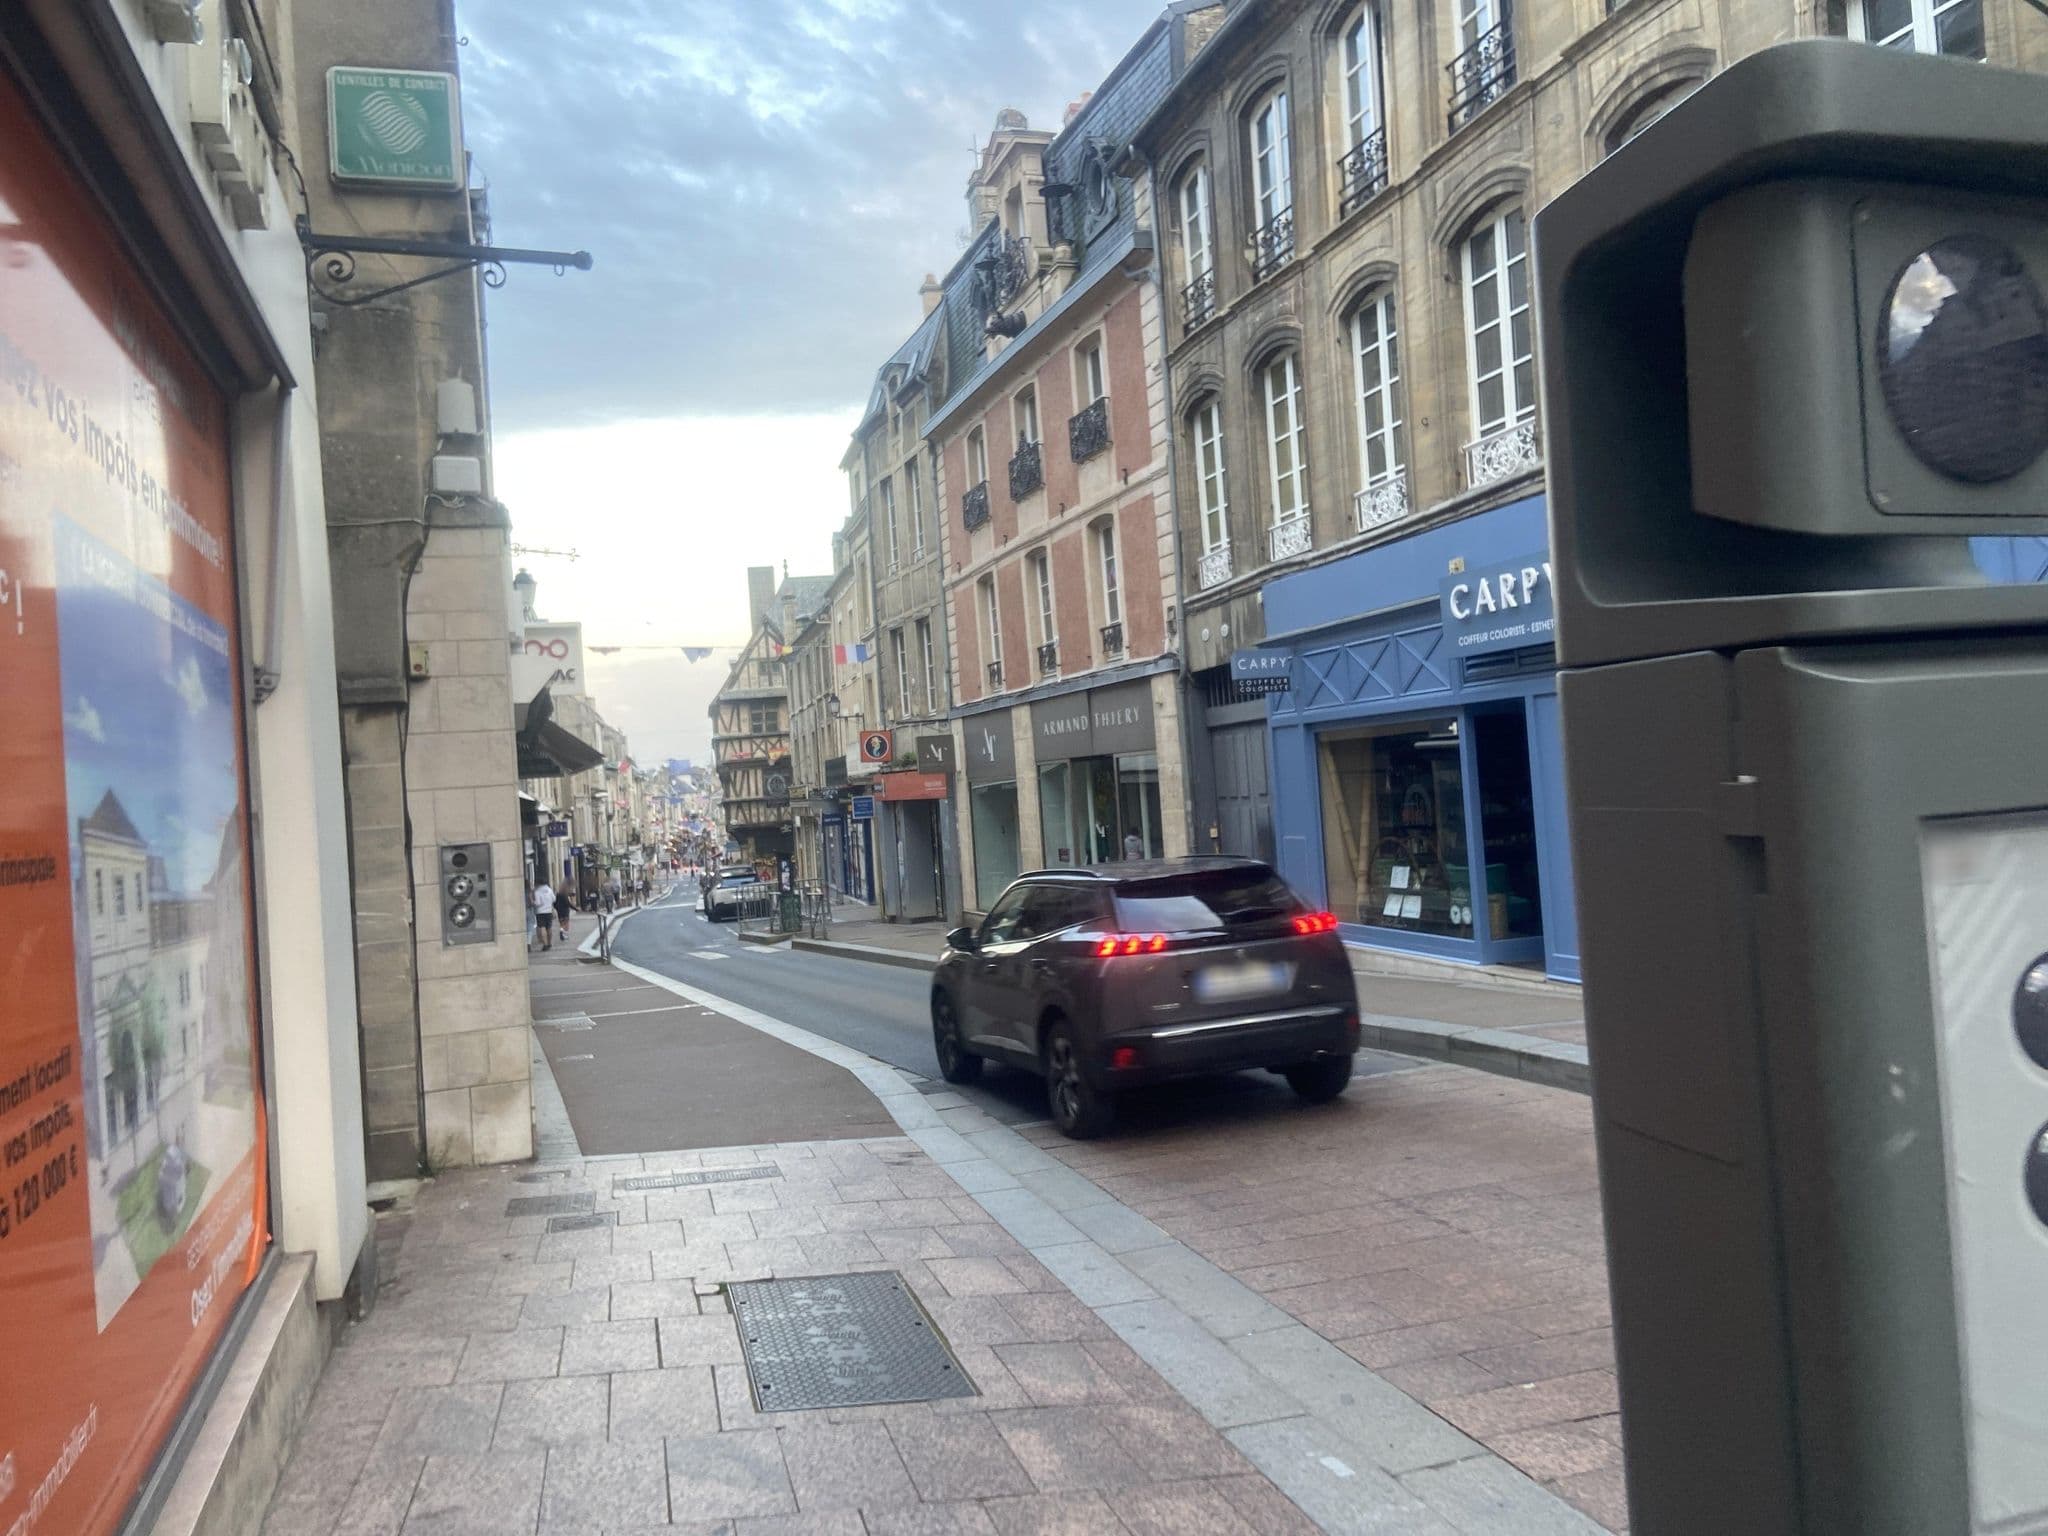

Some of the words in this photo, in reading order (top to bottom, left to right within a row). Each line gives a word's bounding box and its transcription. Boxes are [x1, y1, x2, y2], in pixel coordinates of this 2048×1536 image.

[81, 396, 138, 495] impôts
[1458, 633, 1488, 647] COIFFEUR
[1489, 624, 1525, 641] COLORISTE
[1531, 619, 1554, 633] ESTHET
[1237, 656, 1287, 670] CARPY
[1239, 678, 1288, 687] COIFFEUR
[1239, 685, 1288, 693] COLORISTE
[1043, 715, 1088, 736] ARMAND
[1094, 705, 1139, 728] THIERY
[30, 1098, 73, 1150] impôts
[14, 1173, 39, 1225] 120
[43, 1152, 66, 1200] 000
